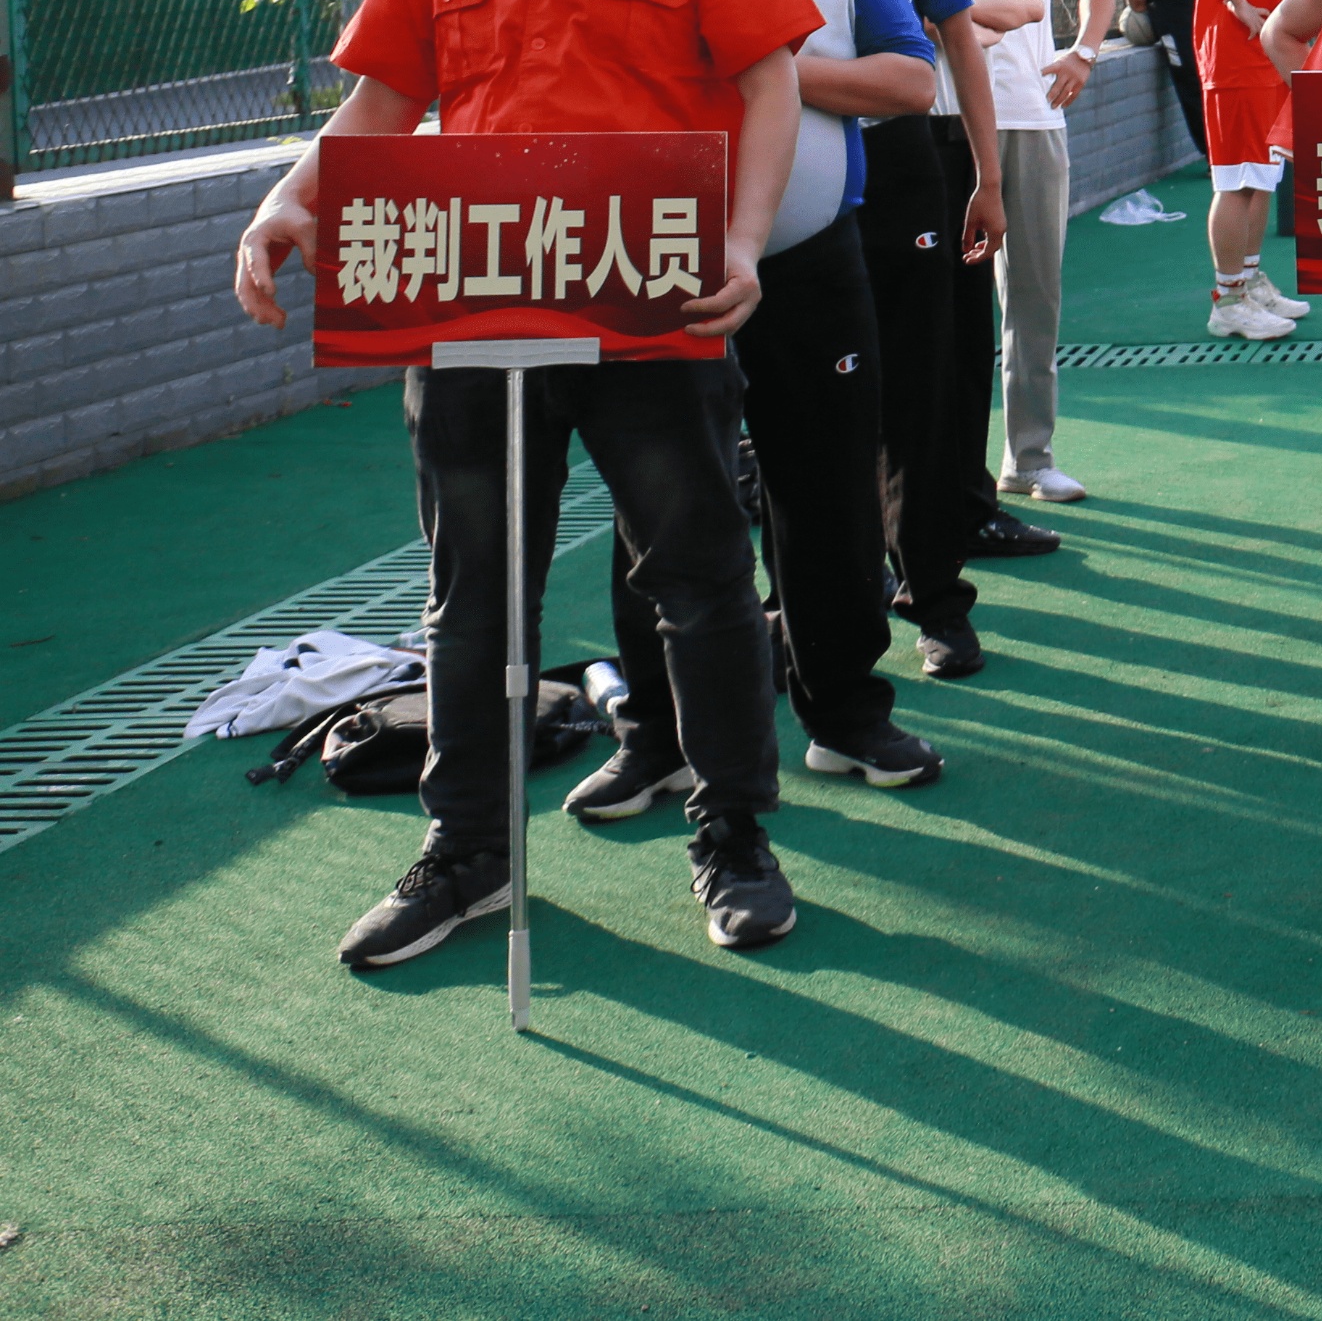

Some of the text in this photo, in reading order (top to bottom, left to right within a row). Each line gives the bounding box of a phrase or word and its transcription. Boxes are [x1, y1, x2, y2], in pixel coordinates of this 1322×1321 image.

[336, 195, 703, 306] 裁判工作人员
